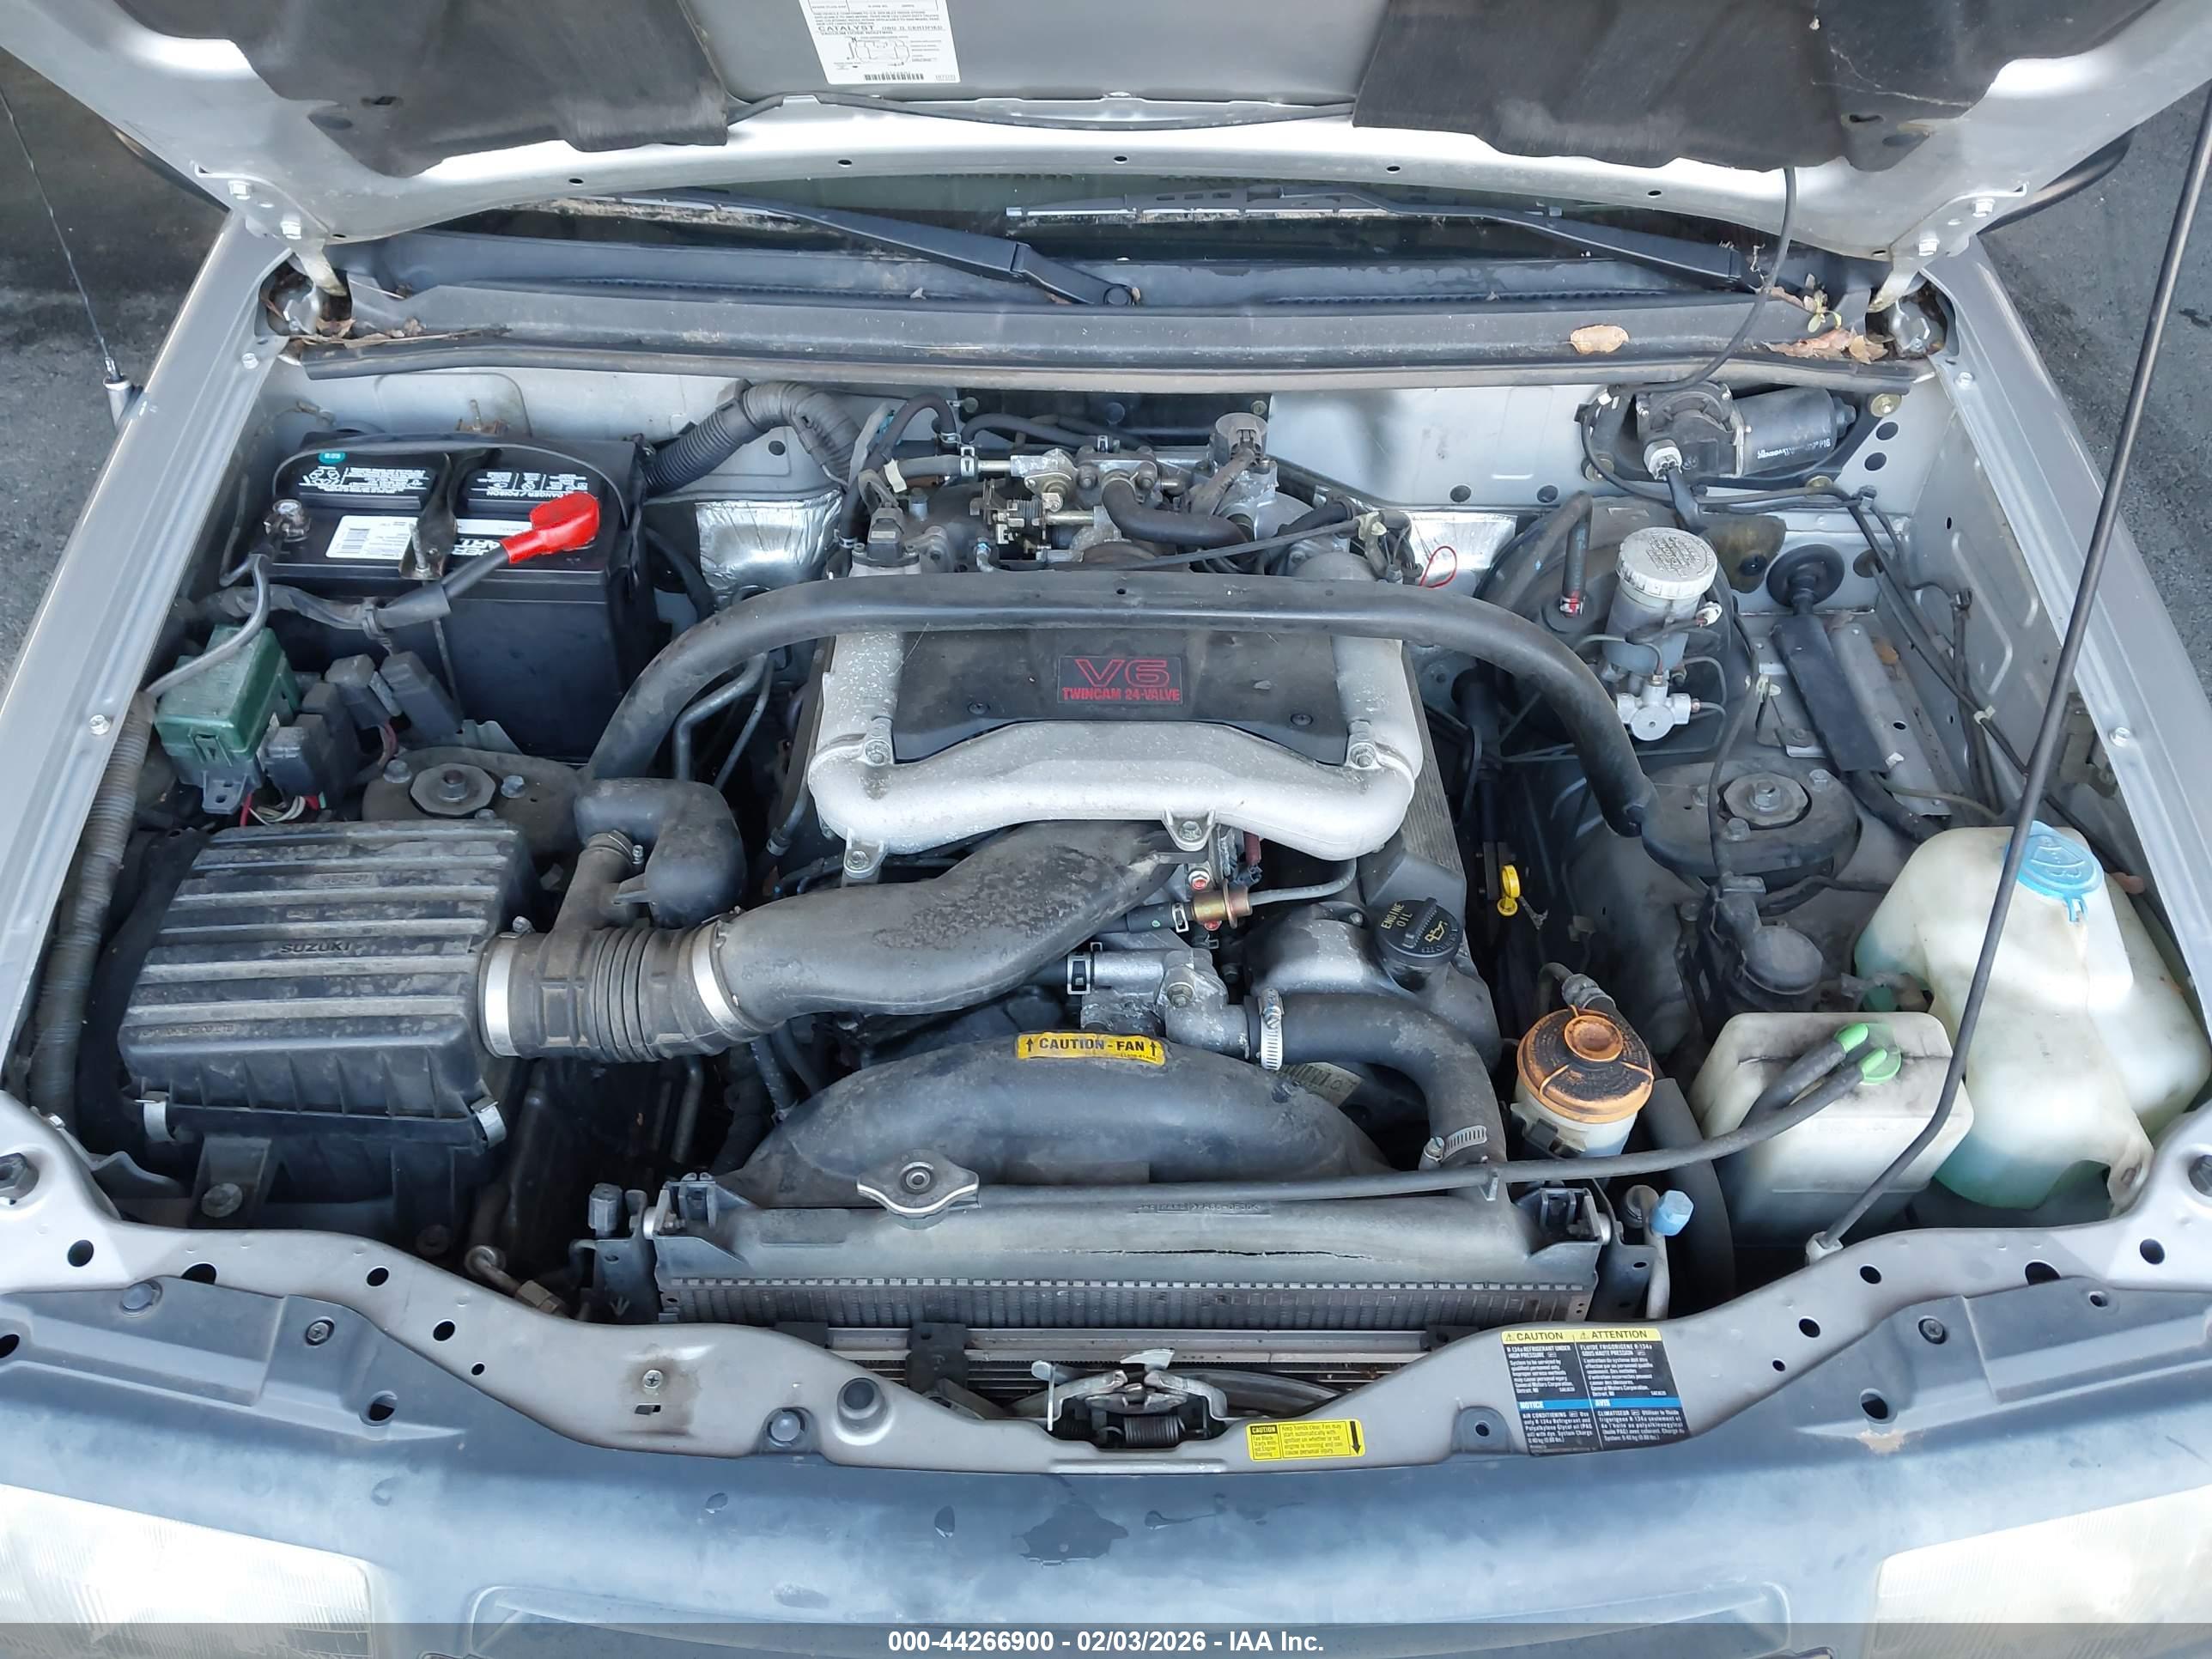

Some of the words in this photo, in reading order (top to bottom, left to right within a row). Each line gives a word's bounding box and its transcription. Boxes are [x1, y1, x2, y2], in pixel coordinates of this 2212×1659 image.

[1075, 659, 1170, 687] V6
[1062, 687, 1121, 701] TWINCAM
[1125, 687, 1181, 702] 24-VALVE
[1380, 902, 1405, 929] ENGINE
[1396, 913, 1413, 927] OIL
[281, 942, 351, 953] SUZUKI
[1039, 1037, 1104, 1050] CAUTION
[1116, 1041, 1145, 1052] FAN
[1516, 1332, 1564, 1340] CAUTION
[1592, 1330, 1648, 1339] ATTENTION
